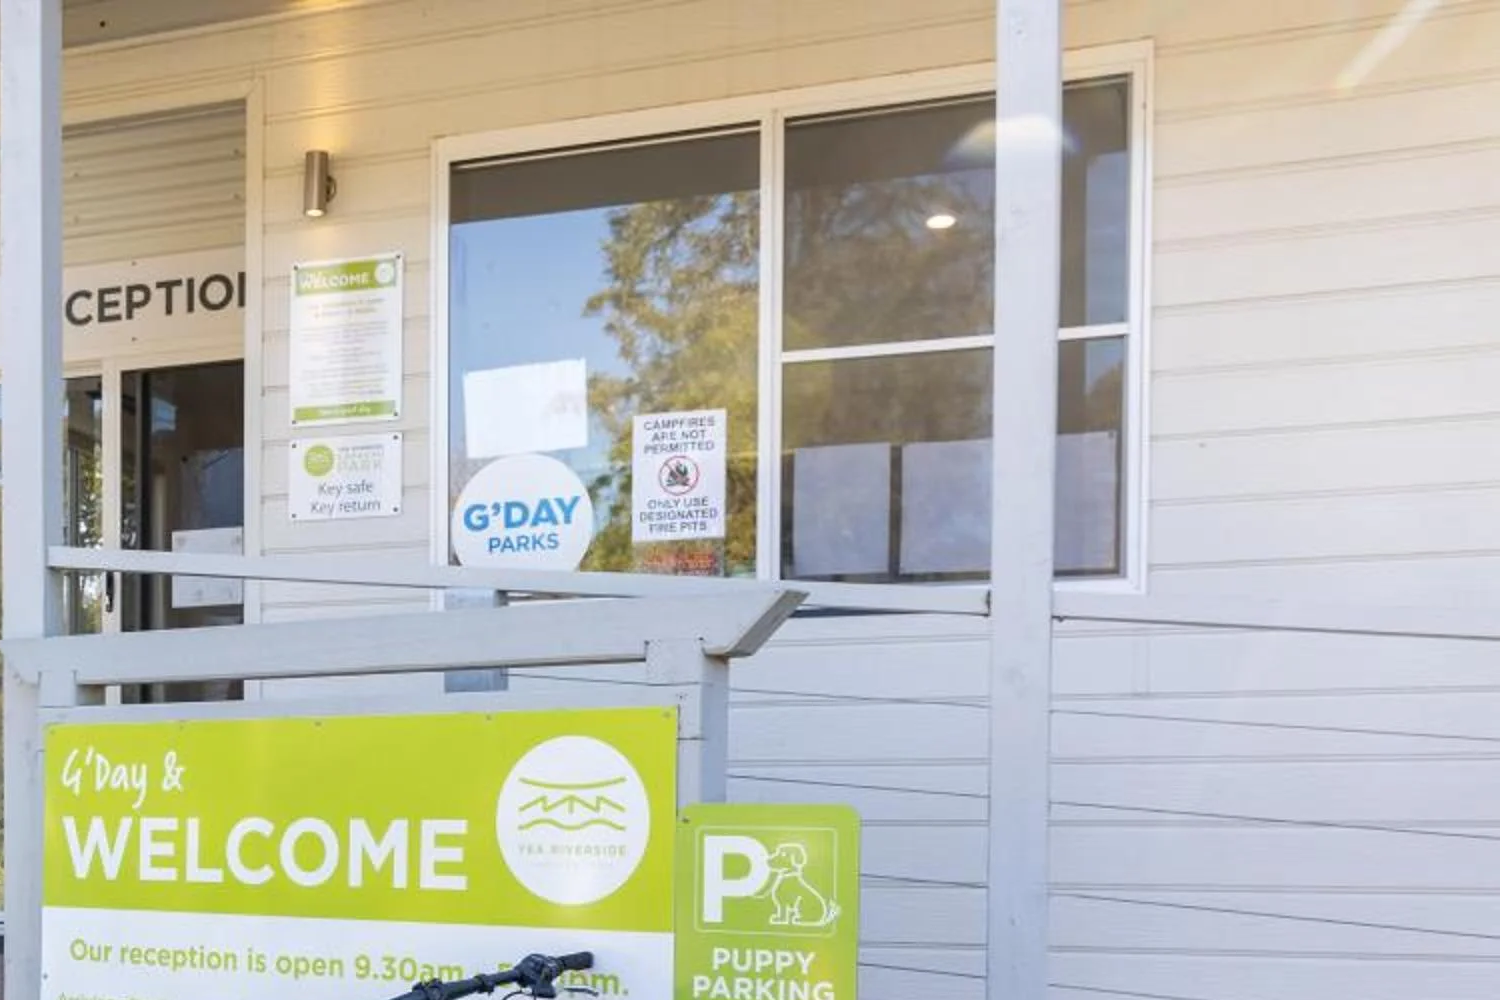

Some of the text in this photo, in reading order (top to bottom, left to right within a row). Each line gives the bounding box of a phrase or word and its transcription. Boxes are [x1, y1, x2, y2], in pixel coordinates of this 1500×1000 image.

[300, 272, 369, 289] WELCOME
[65, 272, 244, 327] CEPTIO
[644, 416, 715, 431] CAMPFIRES
[652, 429, 706, 442] ARE NOT
[644, 441, 715, 454] PERMITTED
[318, 479, 374, 498] Key safe
[311, 499, 381, 517] Key return
[647, 496, 709, 511] ONLY USE
[463, 495, 581, 532] G'DAY
[640, 508, 718, 523] DESIGNATED
[649, 522, 707, 534] FIRE PITS
[488, 533, 559, 553] PARKS
[61, 746, 185, 809] G'Day &
[62, 816, 469, 890] WELCOME
[703, 833, 771, 924] P
[70, 938, 112, 962] Our
[120, 943, 237, 971] reception
[247, 947, 266, 972] is
[276, 955, 344, 979] open
[355, 955, 464, 983] 9.30am
[713, 947, 816, 976] PUPPY
